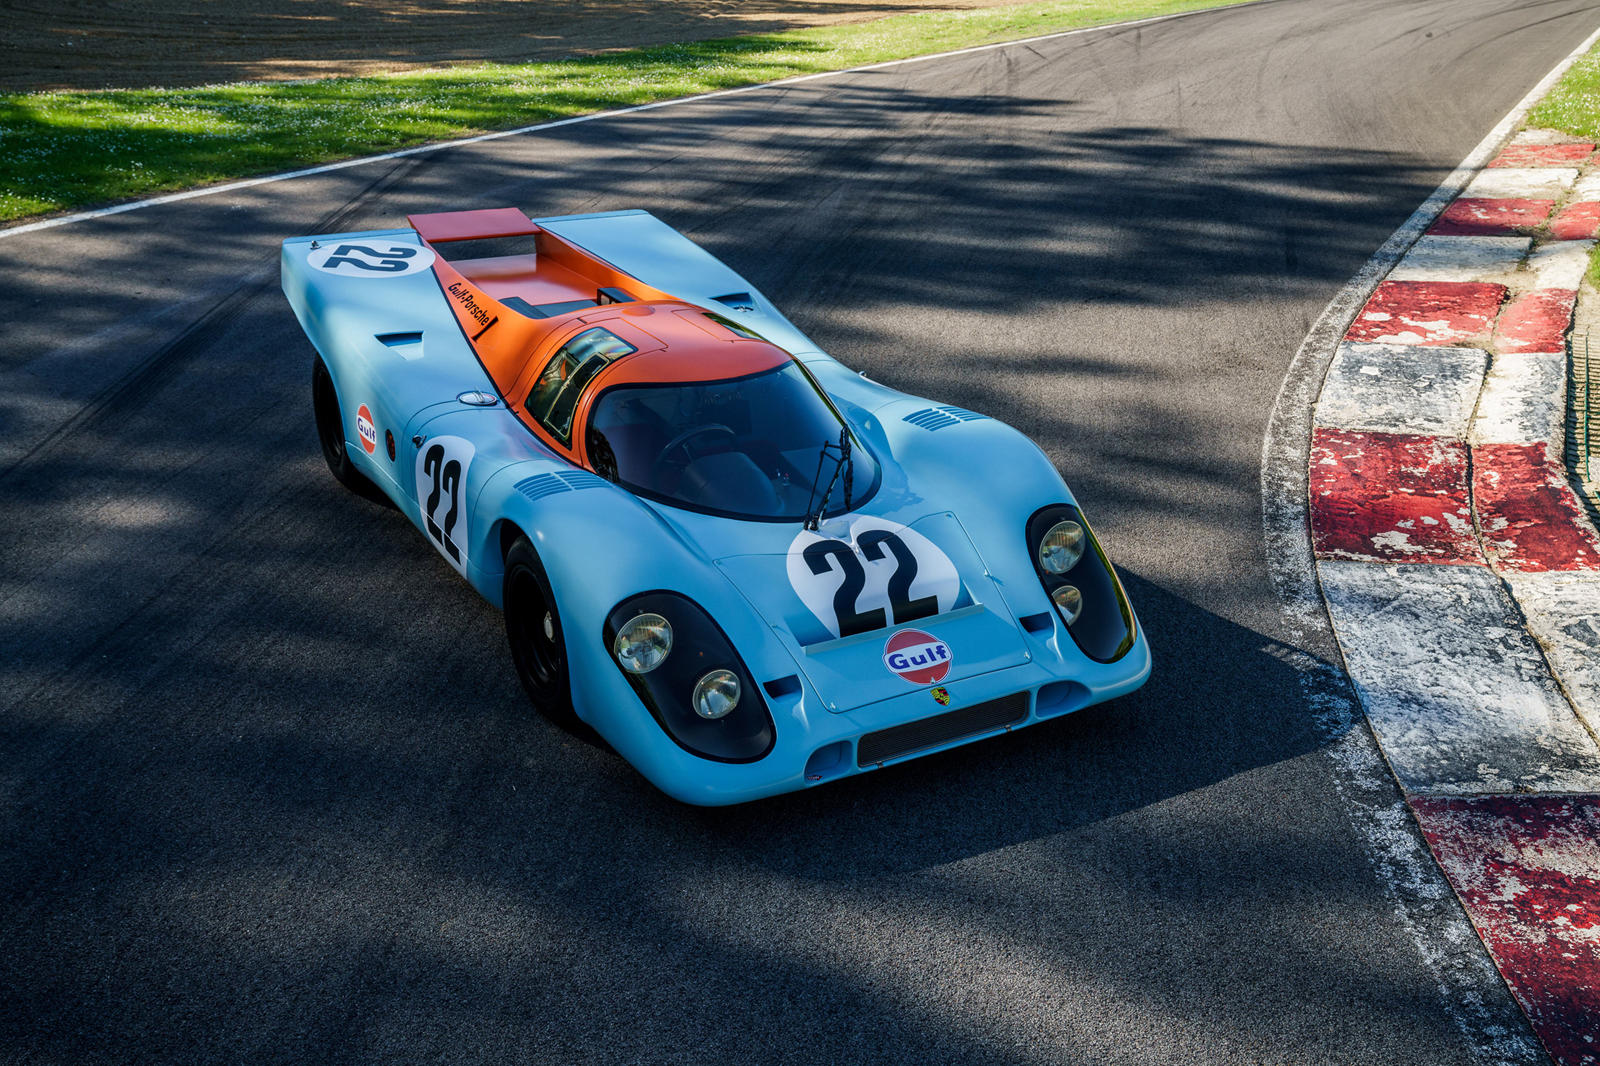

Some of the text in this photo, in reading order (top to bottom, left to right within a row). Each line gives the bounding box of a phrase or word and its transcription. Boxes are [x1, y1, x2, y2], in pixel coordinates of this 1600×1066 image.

[322, 244, 417, 272] 22
[448, 282, 490, 326] Gulf-Porsche
[357, 416, 376, 442] Gulf
[424, 444, 462, 566] 22
[802, 529, 939, 638] 22
[888, 645, 947, 670] Gulf
